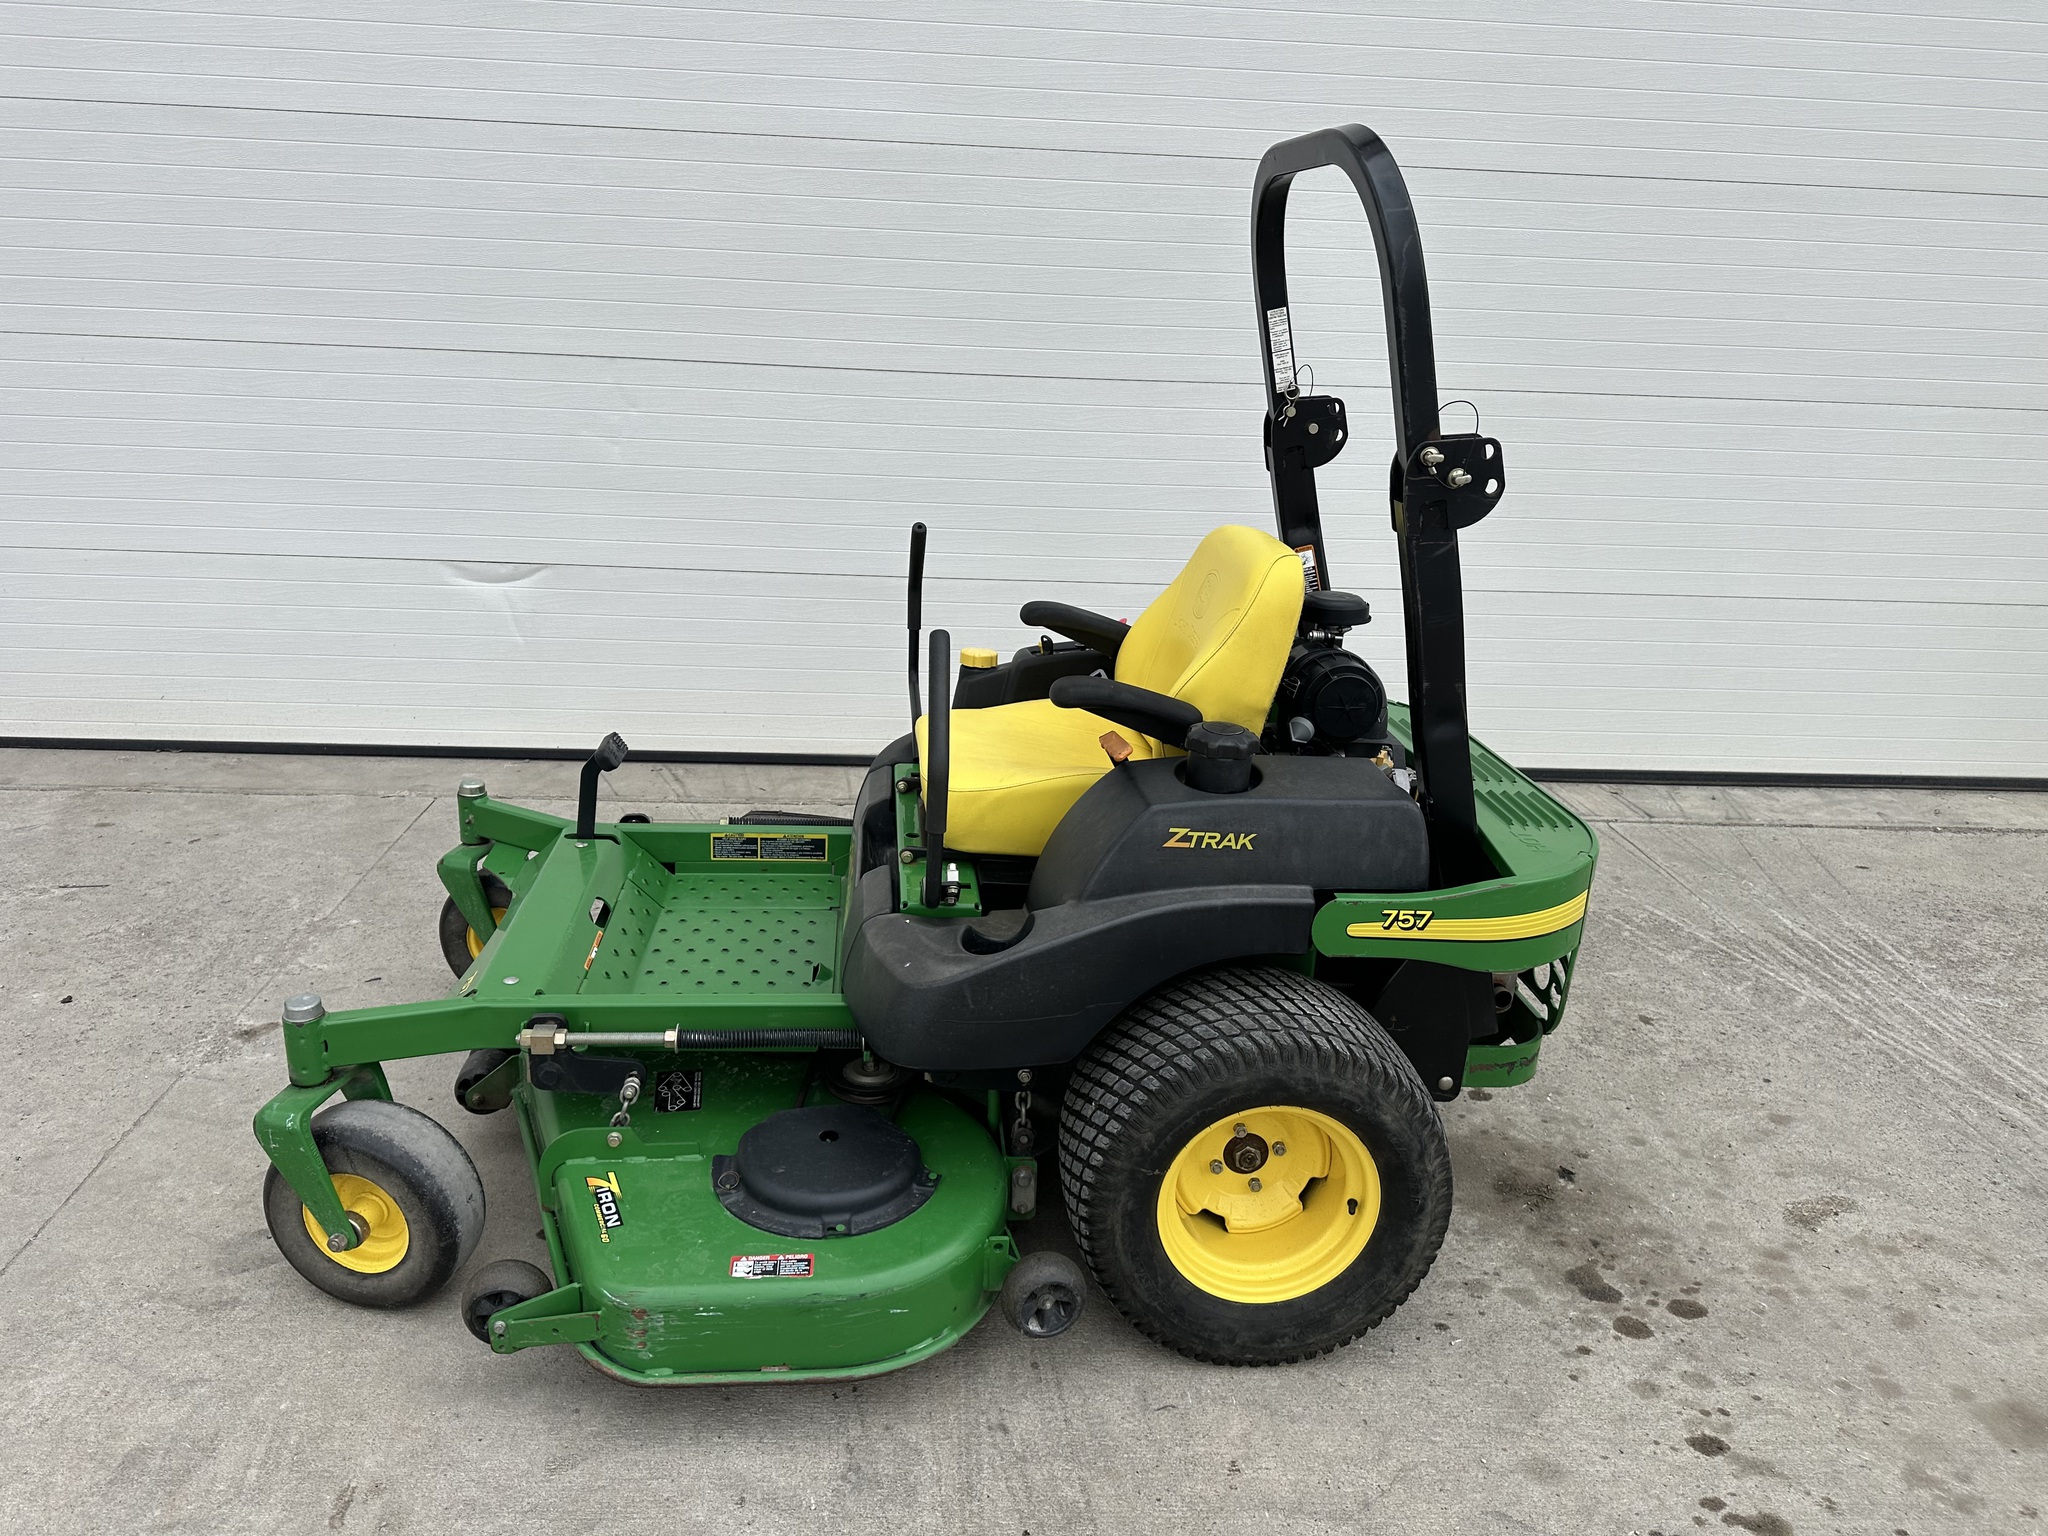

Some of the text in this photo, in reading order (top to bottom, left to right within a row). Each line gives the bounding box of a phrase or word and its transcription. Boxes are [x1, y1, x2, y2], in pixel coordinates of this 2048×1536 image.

[1162, 827, 1258, 850] ZTRAK
[1381, 909, 1434, 931] 757
[595, 1186, 622, 1229] IRON
